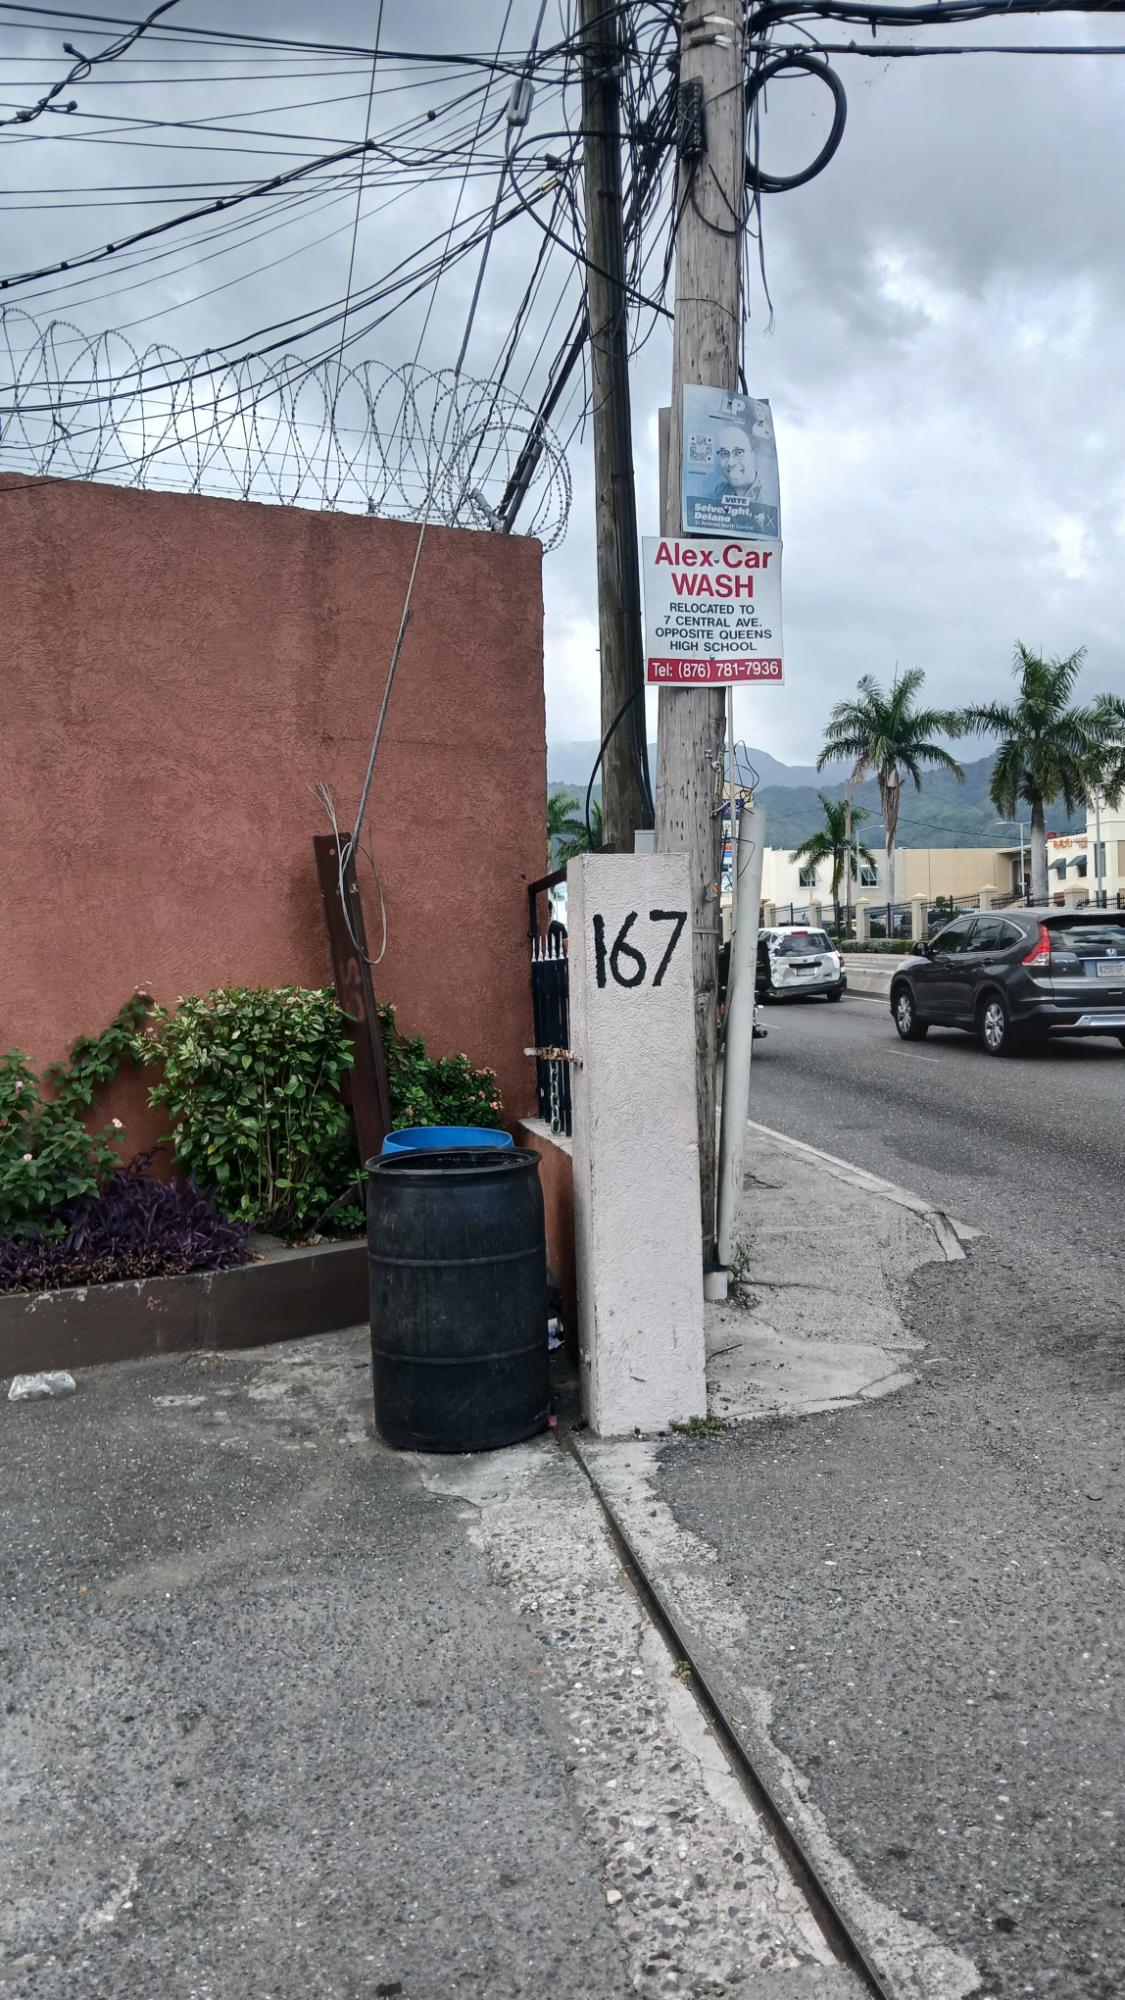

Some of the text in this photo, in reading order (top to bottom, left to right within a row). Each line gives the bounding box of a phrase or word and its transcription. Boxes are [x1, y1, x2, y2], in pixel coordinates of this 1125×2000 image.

[725, 496, 747, 505] VOTE
[694, 503, 752, 517] Seiveight,
[694, 511, 731, 522] Delano
[655, 541, 773, 569] Alex Car
[671, 572, 753, 598] WASH
[669, 602, 755, 615] RELOCATED TO
[663, 615, 763, 628] 7 CENTRAL AVE.
[655, 627, 773, 640] OPPOSITE QUEENS
[669, 640, 757, 653] HIGH SCHOOL
[651, 660, 779, 679] Tel: (876) 781-7936
[592, 909, 688, 989] 167
